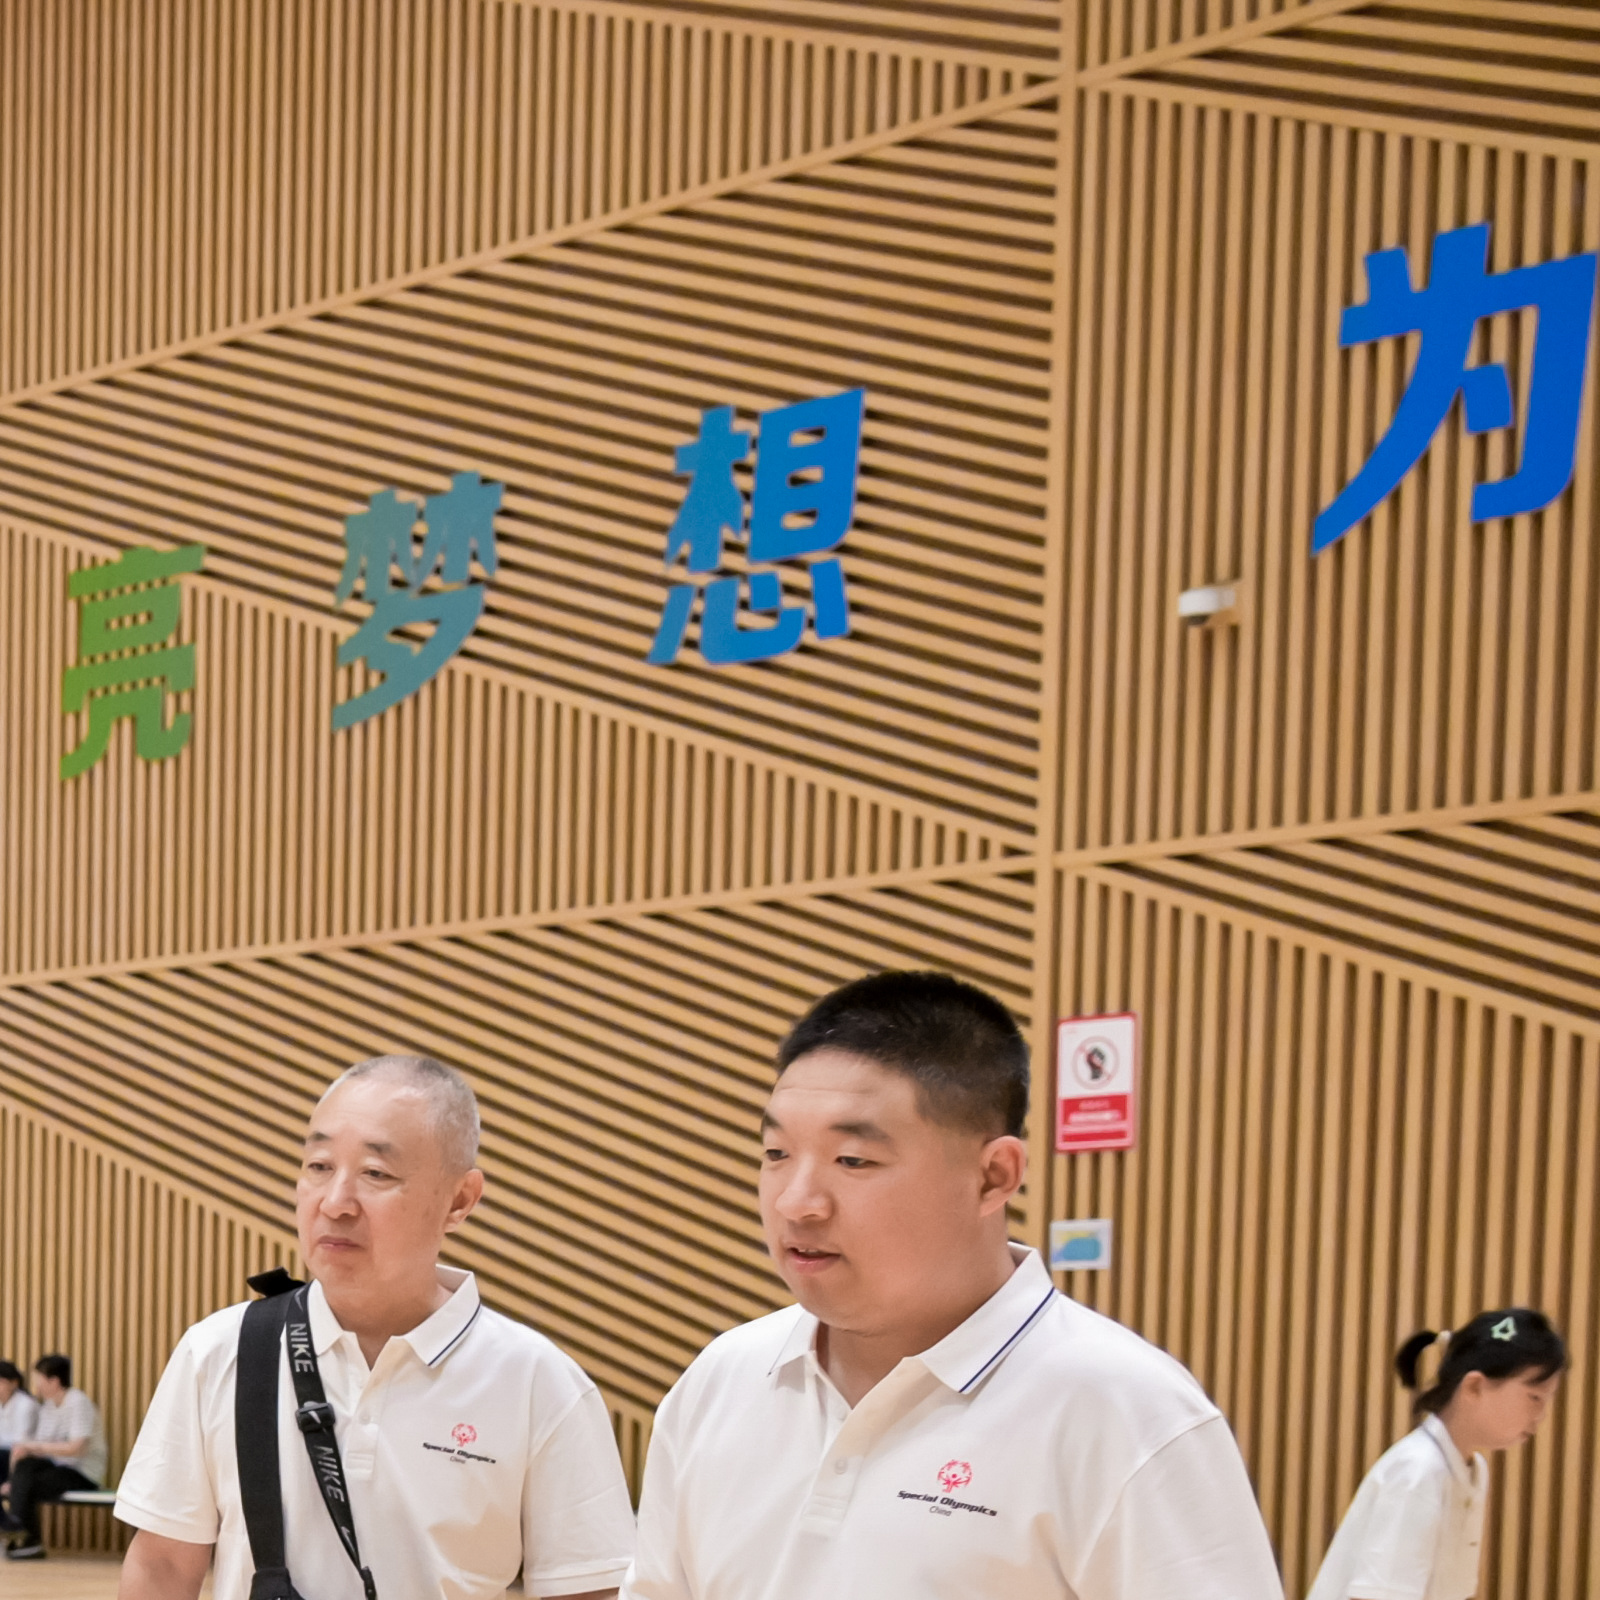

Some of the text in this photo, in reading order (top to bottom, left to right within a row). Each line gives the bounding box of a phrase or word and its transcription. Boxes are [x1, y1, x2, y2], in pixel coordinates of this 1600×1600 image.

[1313, 223, 1600, 555] 为
[290, 1323, 315, 1373] NIKE
[314, 1446, 345, 1503] NIKE
[897, 1490, 998, 1517] Special Olympics
[929, 1505, 952, 1516] China
